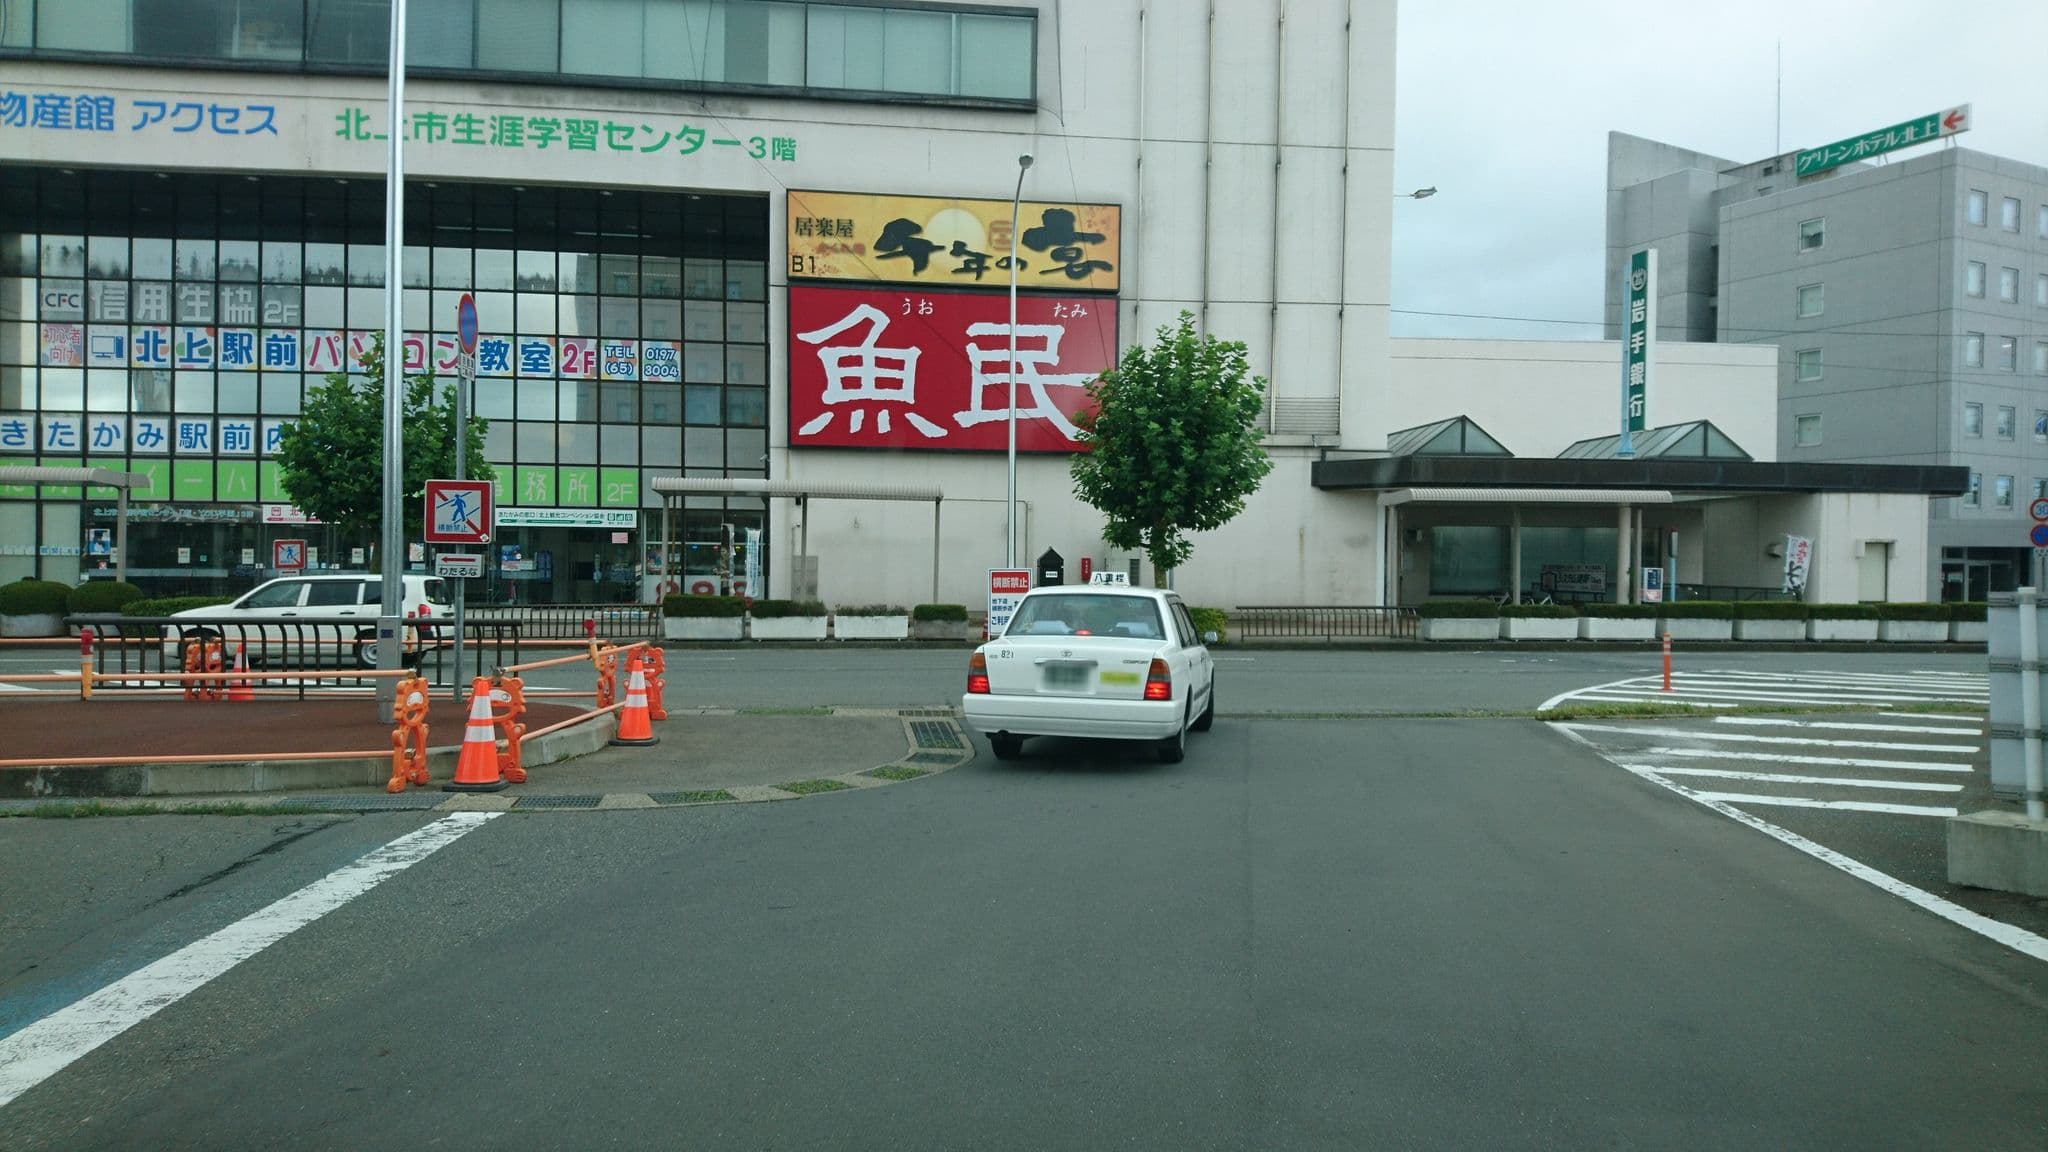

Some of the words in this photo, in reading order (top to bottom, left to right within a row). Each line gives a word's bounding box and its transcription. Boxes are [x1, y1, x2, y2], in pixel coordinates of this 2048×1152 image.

[0, 91, 115, 131] 物産館
[131, 100, 278, 136] アクセス
[1798, 121, 1937, 172] グリーンホテル北上
[794, 217, 854, 238] 居楽屋
[792, 255, 815, 273] B1
[45, 293, 80, 308] CFC
[901, 298, 934, 316] うお
[1053, 303, 1088, 318] たみ
[43, 328, 81, 345] 初心者
[50, 346, 74, 363] 向け
[605, 345, 635, 359] TEL
[645, 347, 676, 361] 0197
[1629, 298, 1645, 418] 岩手銀行
[605, 361, 634, 376] (65)
[796, 304, 1102, 441] 魚民
[438, 566, 479, 577] わたるな
[992, 577, 1028, 588] 横断禁止
[1001, 650, 1014, 659] 821
